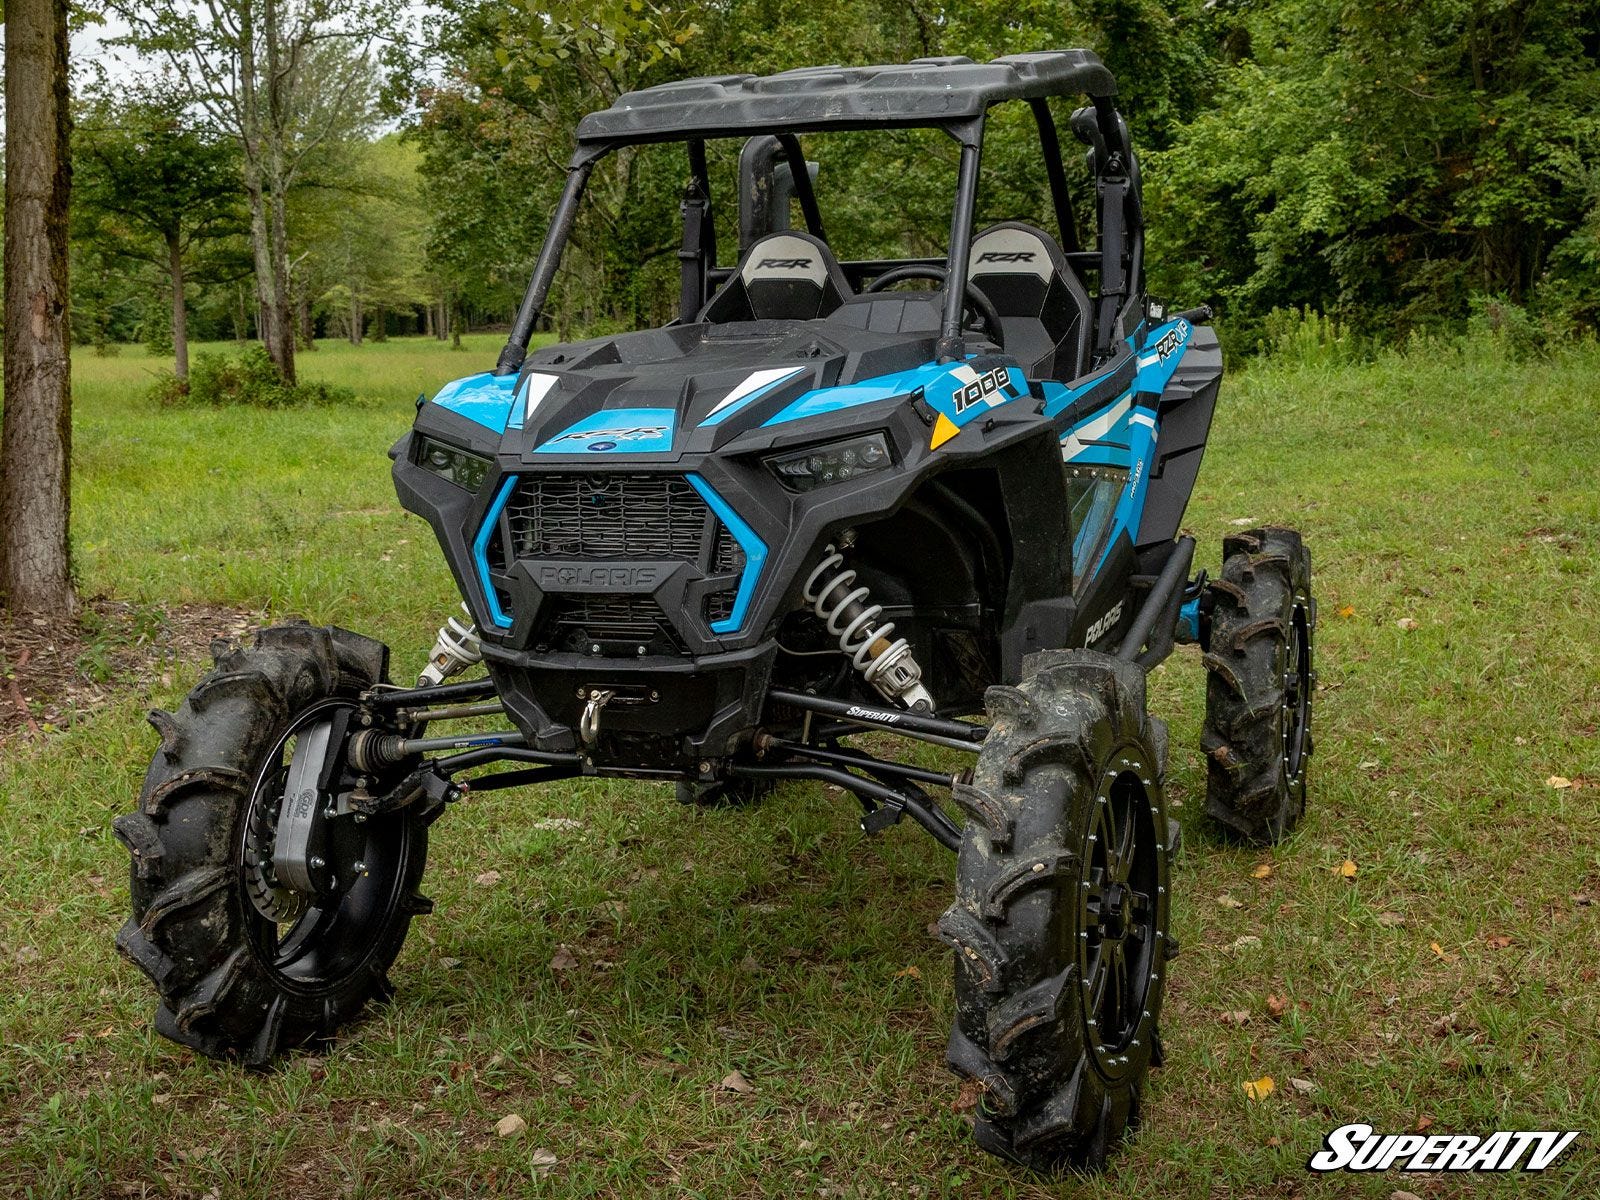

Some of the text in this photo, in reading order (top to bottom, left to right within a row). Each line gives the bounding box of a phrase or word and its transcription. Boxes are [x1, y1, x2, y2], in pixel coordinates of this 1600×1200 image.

[754, 258, 813, 270] RZR
[975, 252, 1037, 264] RZR
[1155, 329, 1184, 367] RZR
[1175, 320, 1188, 342] XP
[953, 366, 1010, 414] 1000
[540, 567, 657, 586] POLARIS
[1084, 600, 1124, 648] POLARIS
[847, 706, 900, 723] SUPERATV
